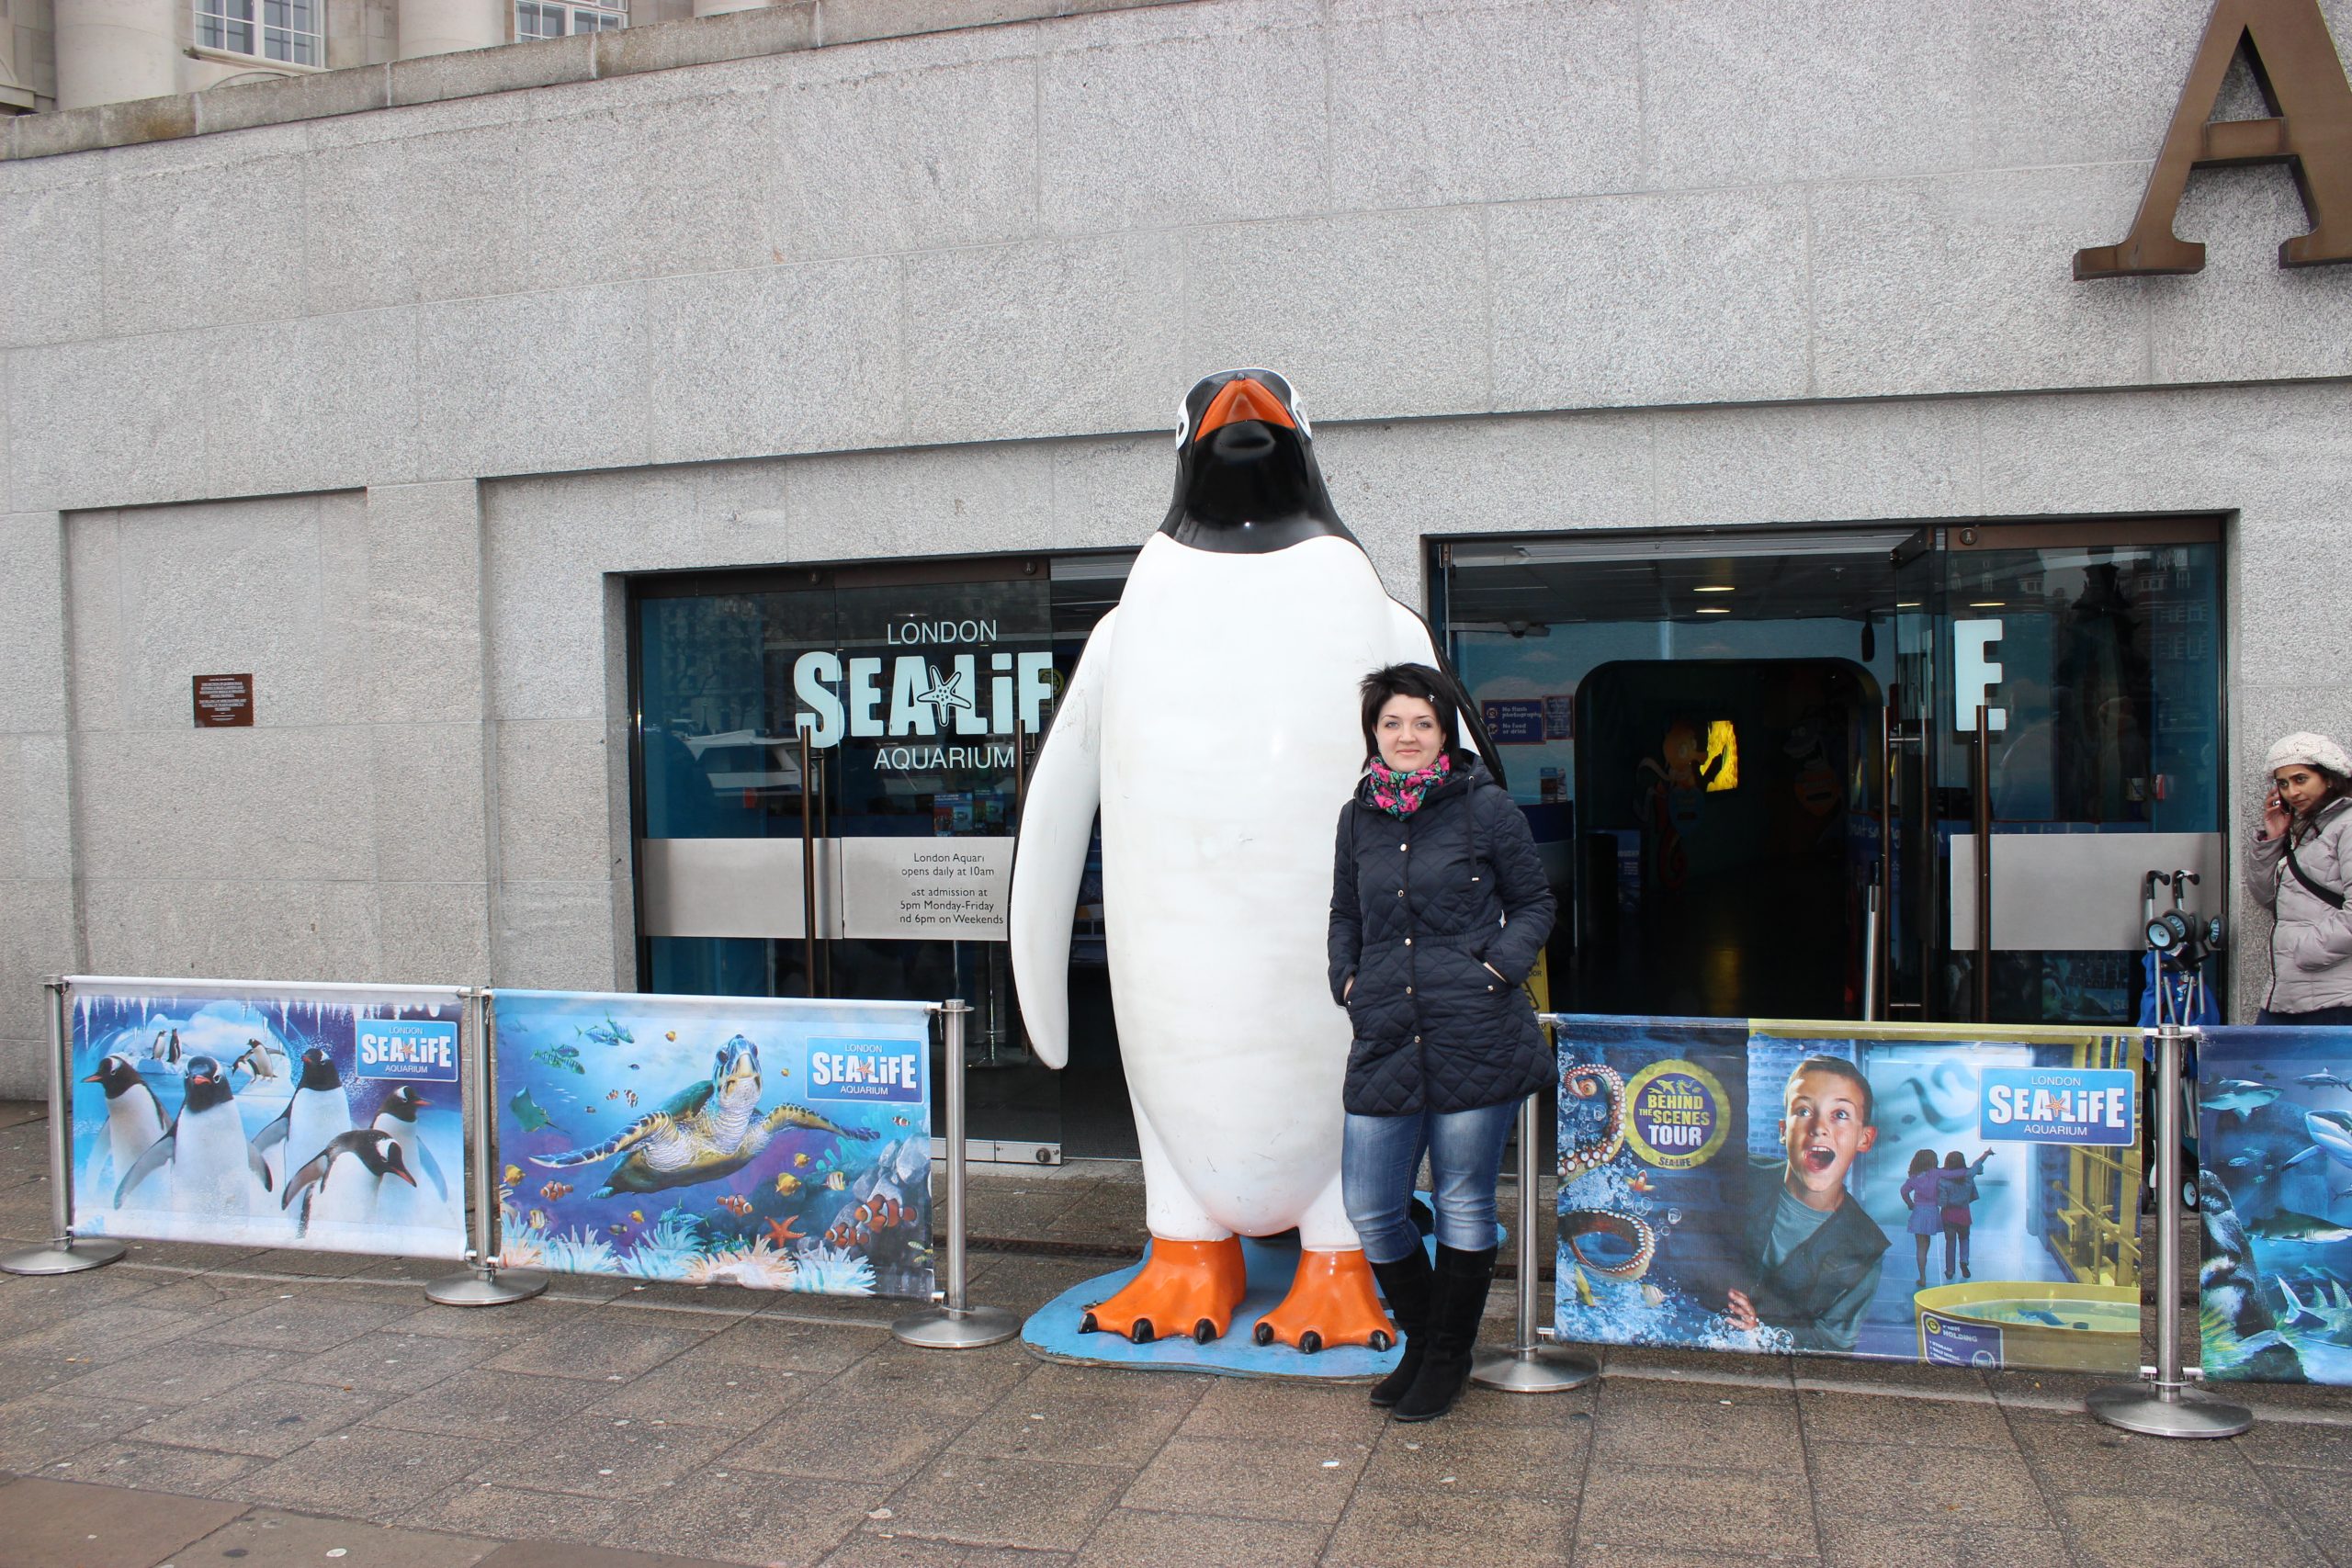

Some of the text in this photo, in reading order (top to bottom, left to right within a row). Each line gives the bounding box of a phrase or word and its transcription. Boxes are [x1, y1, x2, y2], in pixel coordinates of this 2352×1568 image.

[888, 620, 997, 644] LONDON
[874, 747, 1014, 770] AQUARIUM
[914, 853, 950, 863] London
[901, 866, 995, 878] opens daily at 10am
[928, 886, 975, 897] admission
[978, 888, 989, 897] at
[900, 900, 994, 912] 5pm Monday-Friday
[915, 914, 935, 925] 6pm
[953, 914, 1004, 924] Weekends
[845, 1043, 883, 1053] LONDON
[385, 1065, 428, 1073] AQUARIUM
[2031, 1076, 2081, 1086] LONDON
[841, 1086, 888, 1095] AQUARIUM
[1647, 1094, 1703, 1110] BEHIND
[1638, 1108, 1710, 1126] THE SCENES
[1648, 1124, 1702, 1146] TOUR
[2024, 1124, 2087, 1135] AQUARIUM
